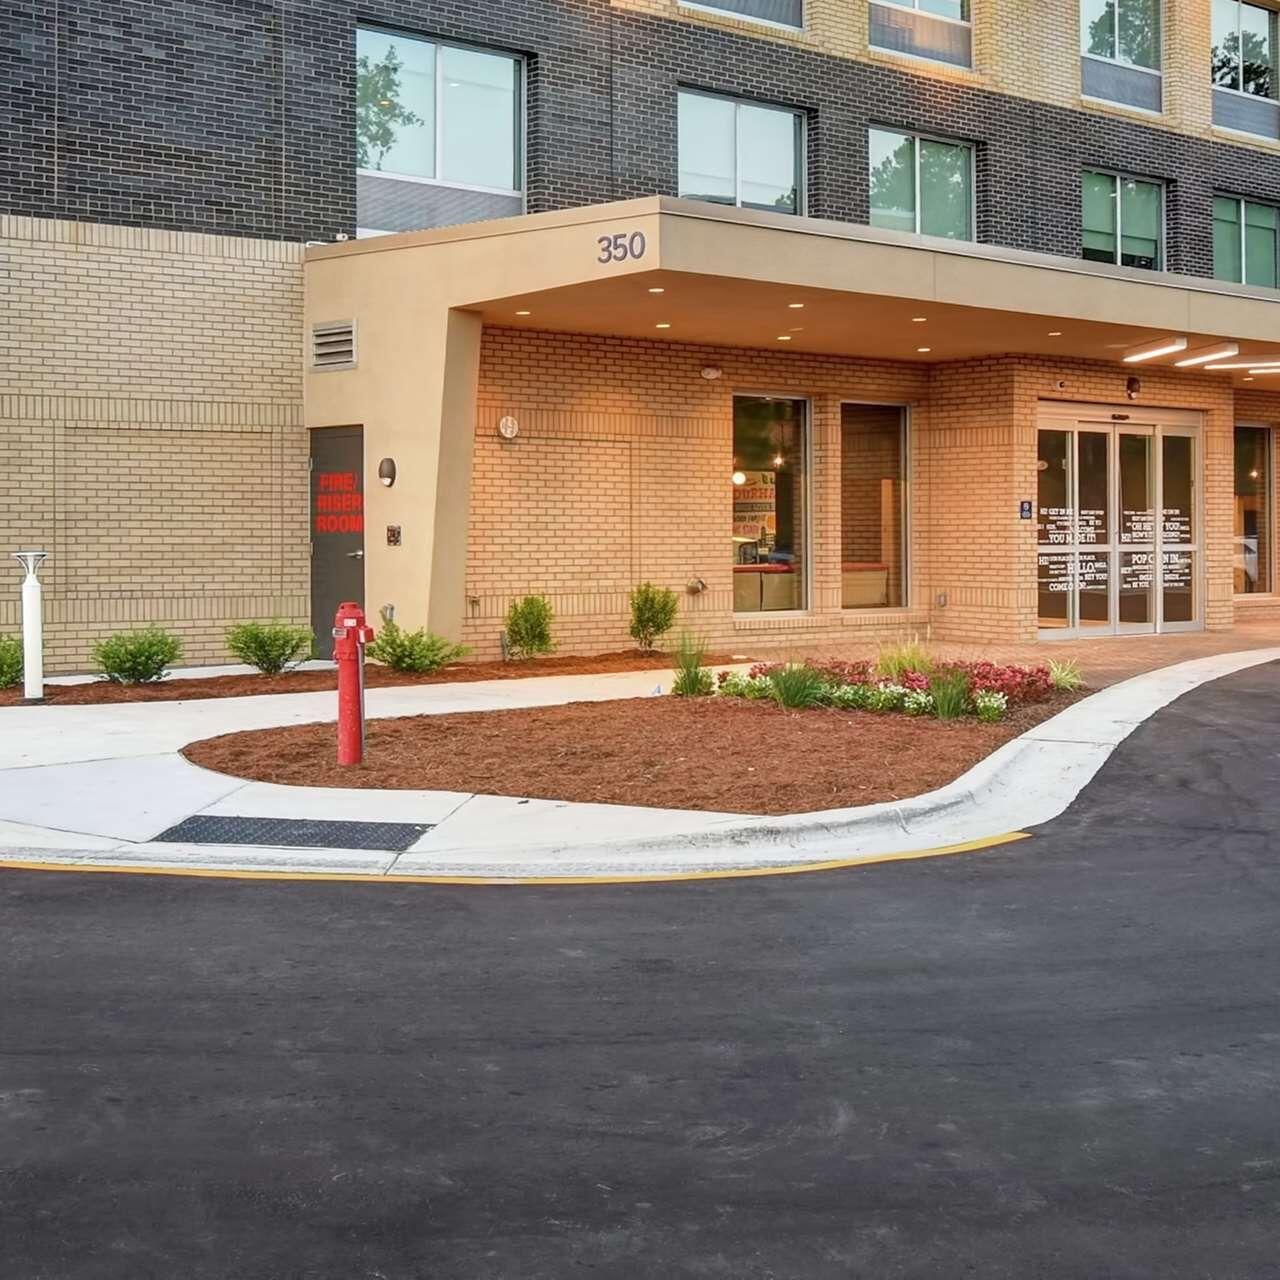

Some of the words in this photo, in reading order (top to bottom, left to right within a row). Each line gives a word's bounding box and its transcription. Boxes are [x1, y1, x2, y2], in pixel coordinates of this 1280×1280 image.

[598, 231, 646, 264] 350
[316, 493, 362, 512] RISER
[316, 514, 363, 533] ROOM
